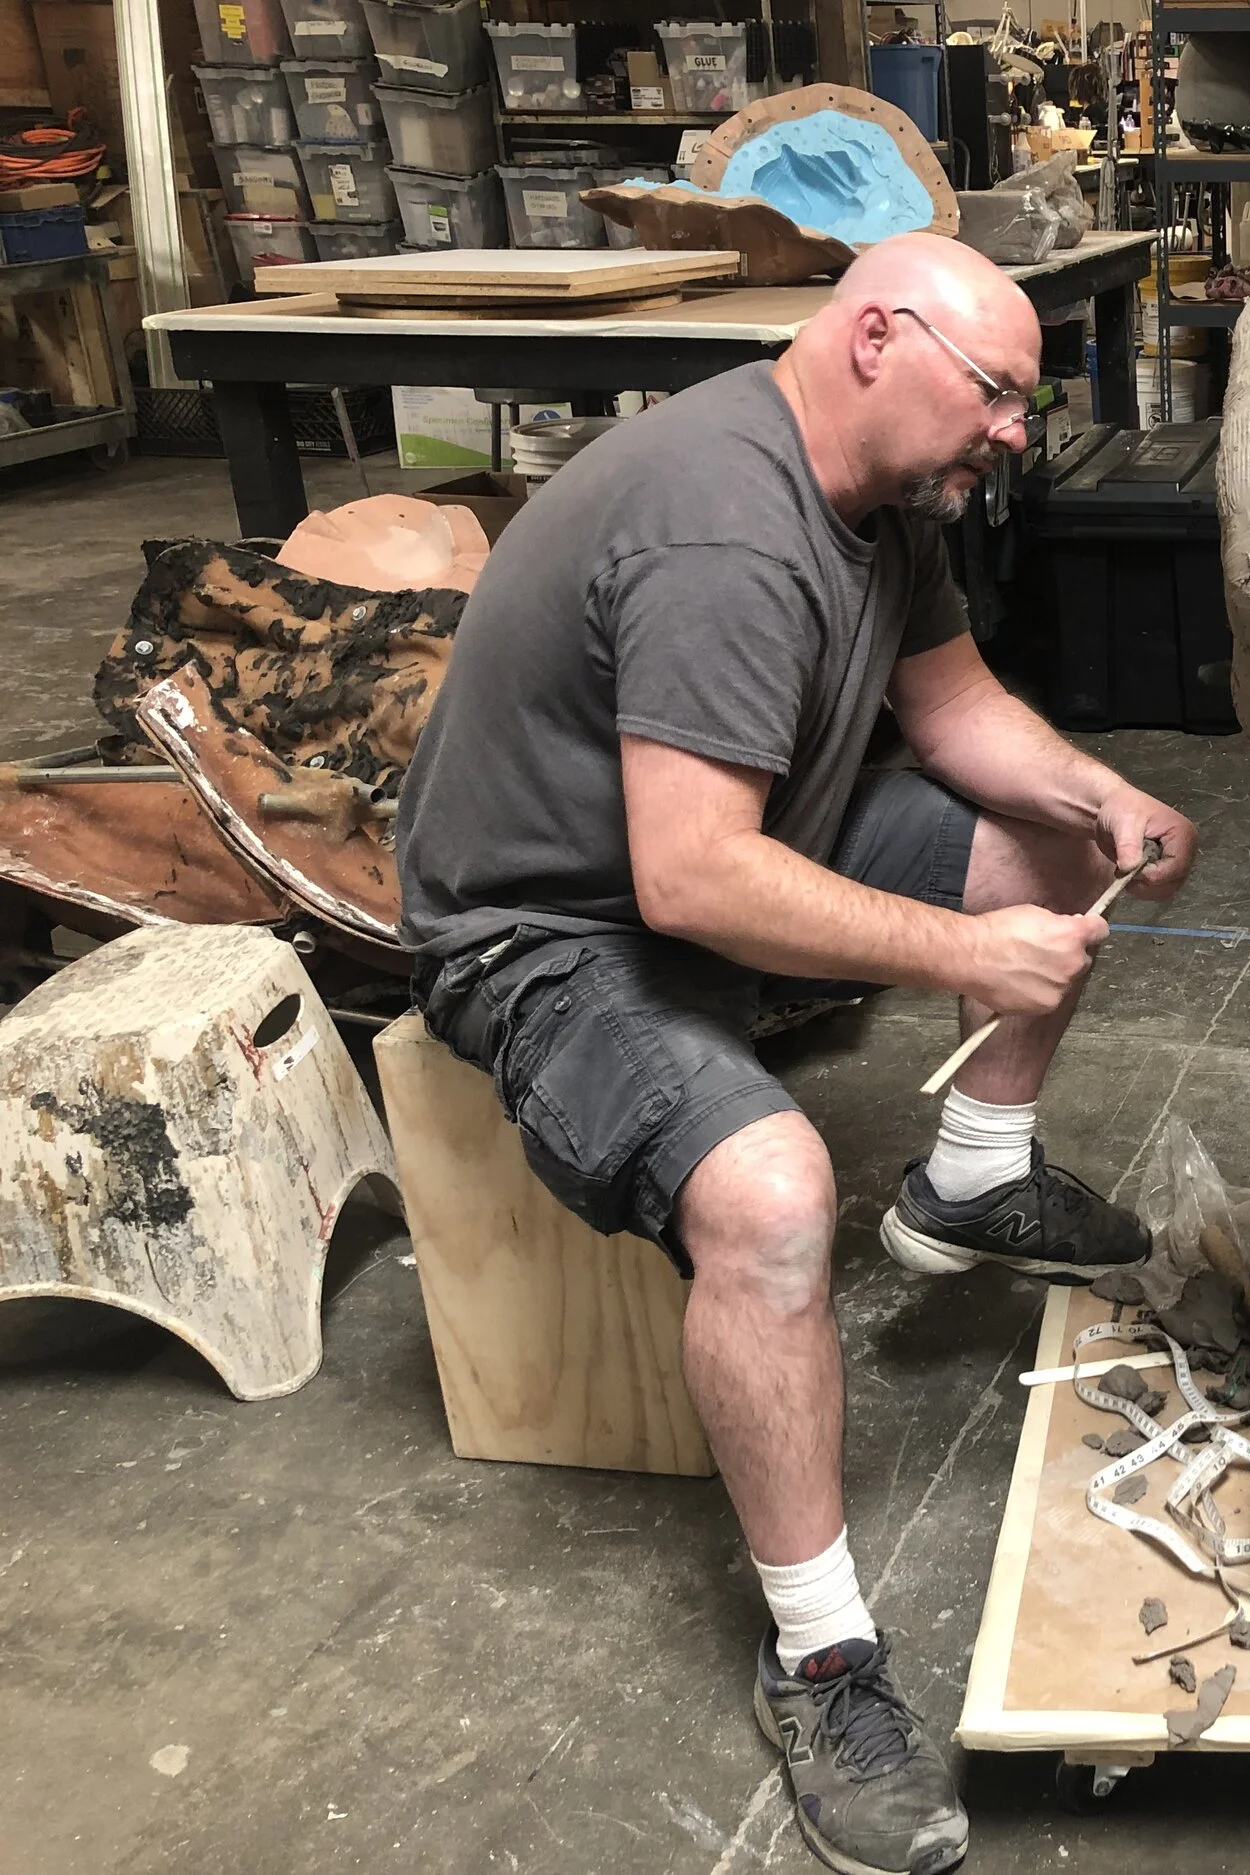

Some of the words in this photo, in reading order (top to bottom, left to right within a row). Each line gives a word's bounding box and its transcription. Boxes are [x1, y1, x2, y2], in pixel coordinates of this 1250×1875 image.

[694, 57, 718, 68] GLUE
[1113, 1465, 1127, 1478] 42
[1131, 1454, 1145, 1467] 43
